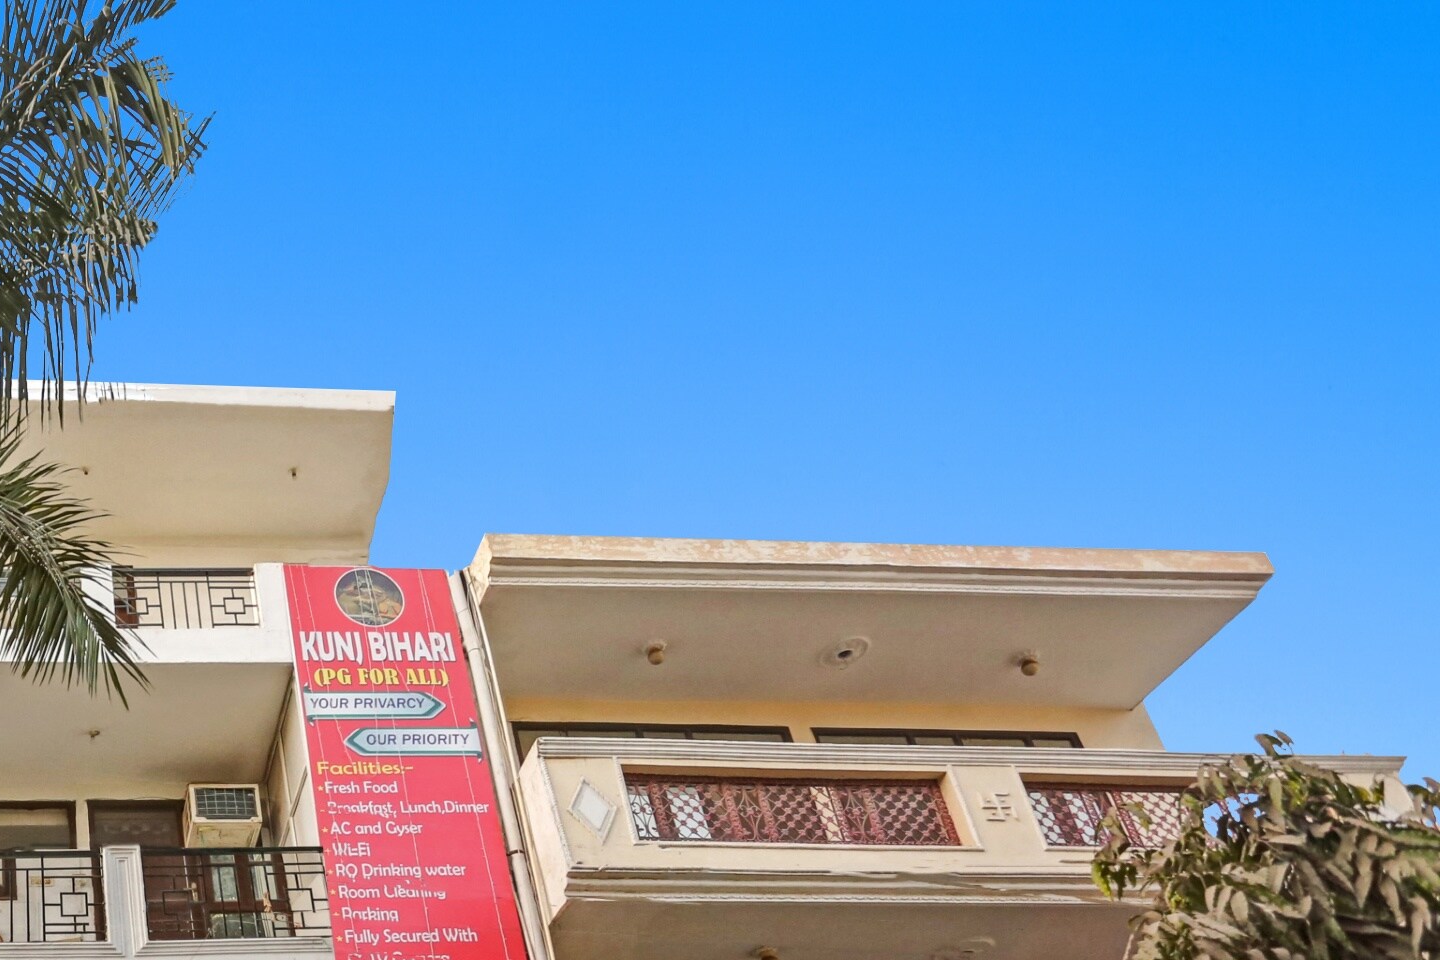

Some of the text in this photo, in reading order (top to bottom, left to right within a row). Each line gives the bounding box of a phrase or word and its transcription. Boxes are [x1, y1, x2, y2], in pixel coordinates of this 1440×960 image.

[299, 631, 456, 665] KUNJ BIHARI
[314, 668, 448, 686] (PG FOR ALL)
[310, 697, 425, 709] YOUR PRIVARCY
[366, 733, 470, 745] OUR PRIORITY
[324, 781, 399, 794] Fresh Food
[330, 821, 423, 837] AC and Gyser
[362, 862, 421, 879] Drinking
[425, 864, 466, 876] water
[338, 884, 380, 899] Room
[343, 927, 478, 946] Fully Secured With
